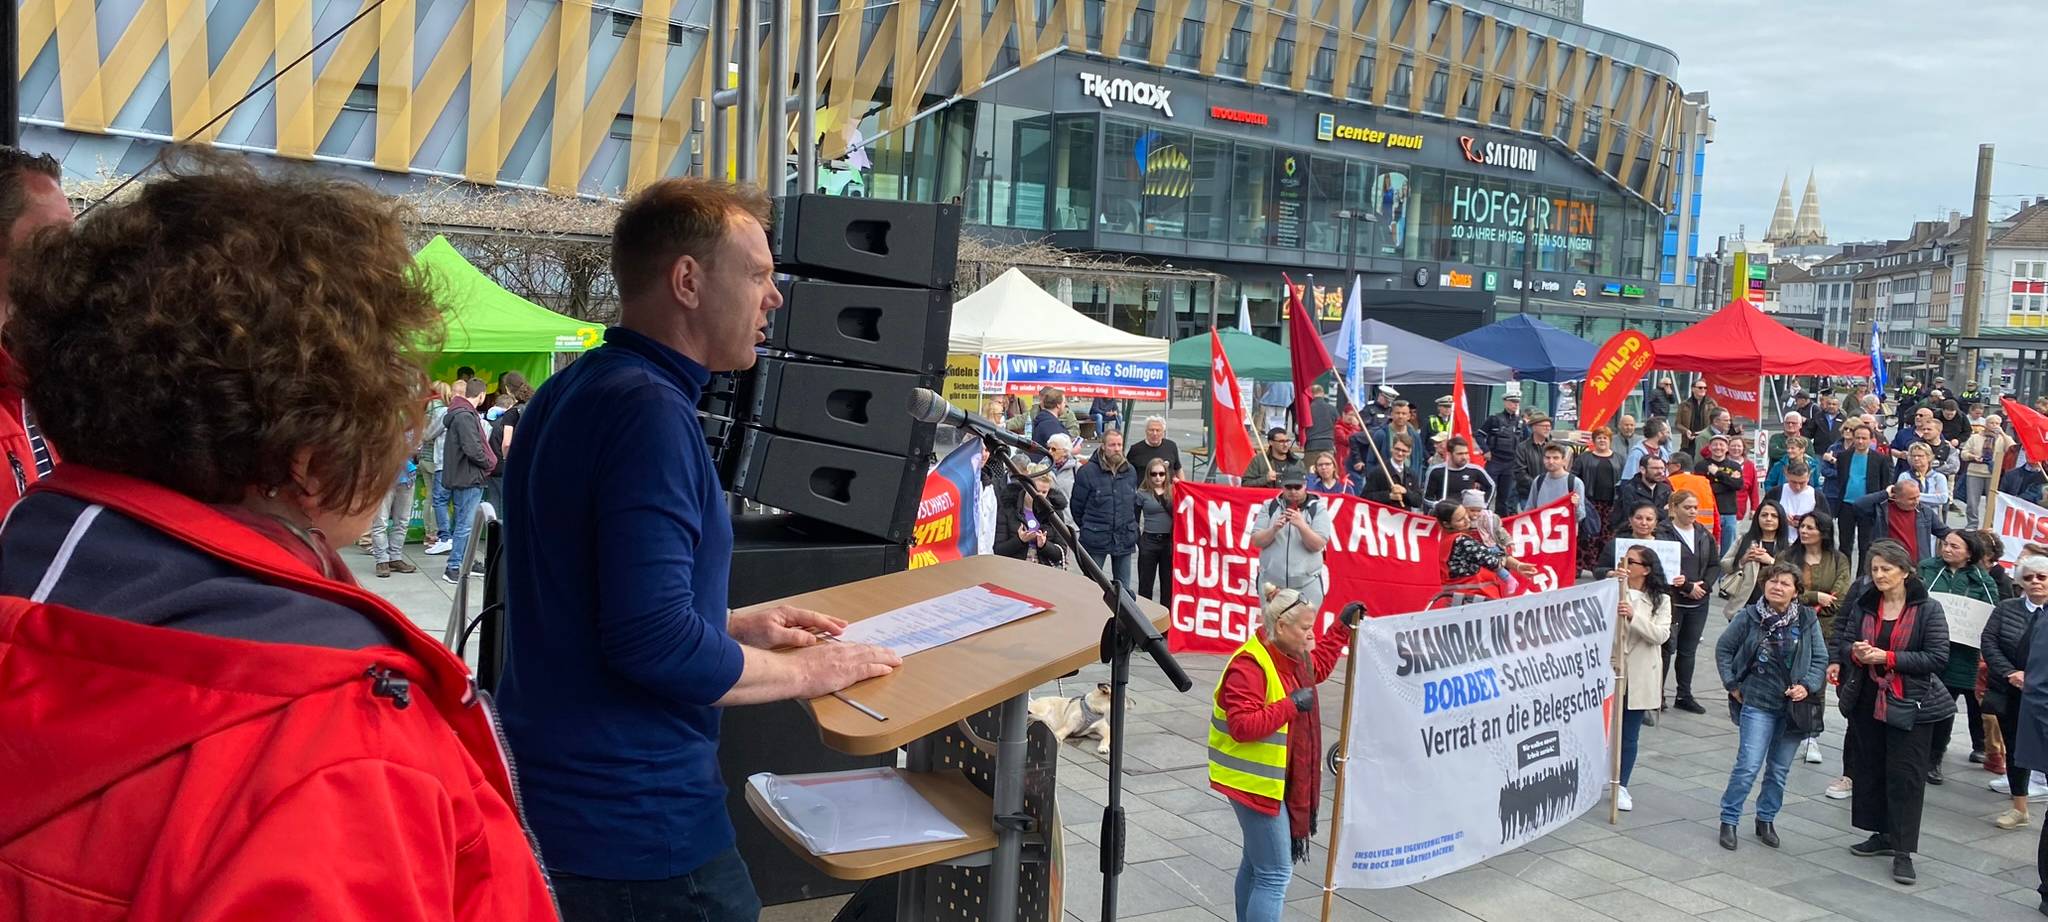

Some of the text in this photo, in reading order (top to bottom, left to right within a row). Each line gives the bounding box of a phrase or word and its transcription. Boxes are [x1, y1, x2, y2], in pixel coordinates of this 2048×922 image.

[1211, 106, 1268, 126] WOOLWORTH
[1336, 124, 1386, 143] center
[1387, 134, 1424, 150] pauli
[1485, 141, 1537, 171] SATURN
[1452, 225, 1464, 238] 10
[1467, 226, 1497, 241] JAHRE
[1551, 235, 1592, 251] SOLINGEN
[1012, 358, 1038, 374] VVN
[1048, 359, 1071, 374] BdA
[1082, 361, 1111, 377] Kreis
[1114, 364, 1163, 381] Solingen
[1601, 337, 1640, 381] MLPD
[1173, 594, 1264, 642] GEGE
[1395, 596, 1608, 677] SKANDAL IN SOLINGEN!
[1424, 668, 1500, 714] BORBET
[1584, 642, 1601, 670] ist
[1421, 717, 1477, 758] Verrat
[1482, 716, 1501, 743] an
[1506, 703, 1530, 735] die
[1354, 847, 1393, 859] INSOLVENZ
[1395, 846, 1402, 855] IN
[1390, 858, 1404, 868] ZUM
